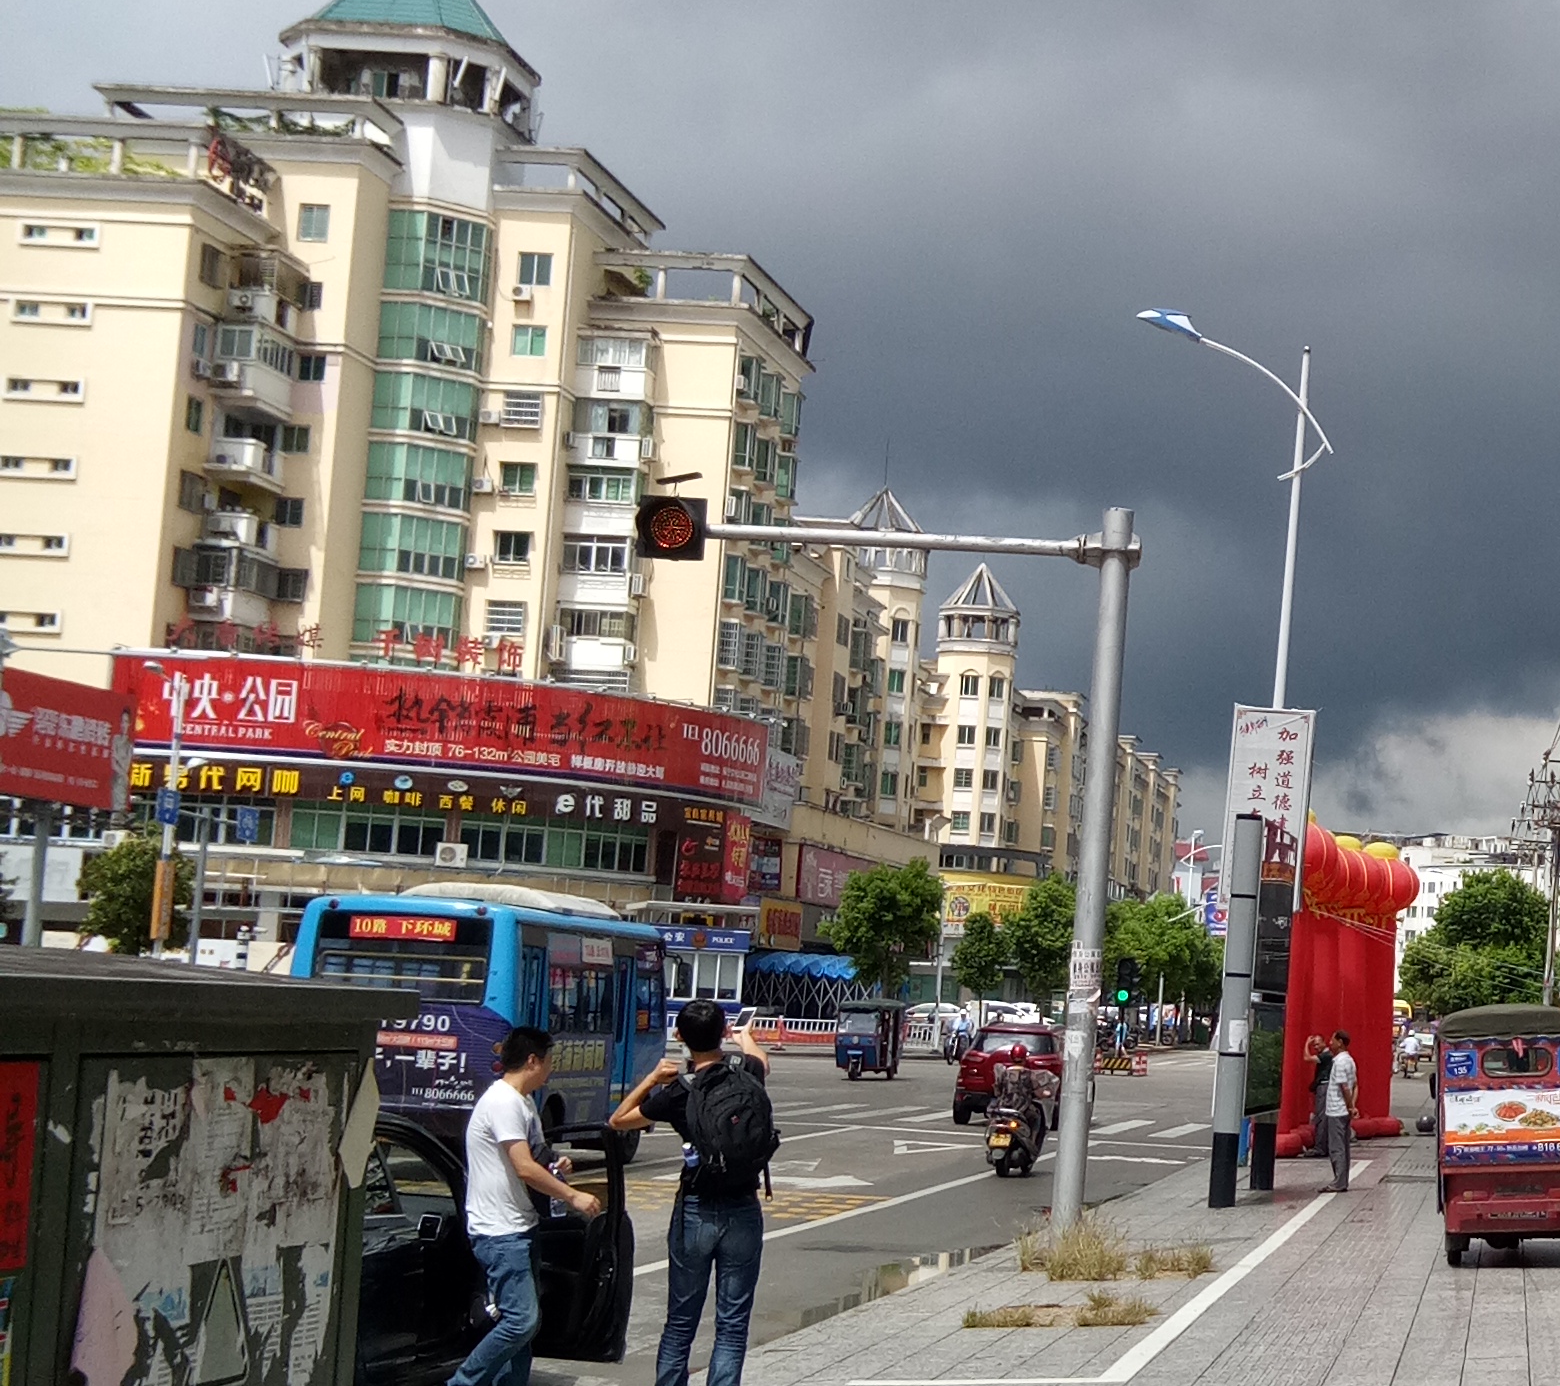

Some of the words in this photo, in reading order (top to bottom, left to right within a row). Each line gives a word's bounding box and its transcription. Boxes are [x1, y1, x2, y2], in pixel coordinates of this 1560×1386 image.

[162, 671, 220, 720] 中央
[237, 676, 299, 724] 公园
[179, 722, 237, 739] CENTRAL
[237, 725, 273, 741] PARK
[681, 722, 700, 741] TEL
[701, 726, 761, 767] 8066666
[383, 738, 443, 758] 实力封顶
[327, 785, 366, 803] 上网
[382, 790, 423, 807] 咖啡
[438, 795, 476, 811] 西餐
[490, 797, 527, 815] 休闲
[1247, 762, 1270, 816] 树立
[354, 917, 387, 934] 10路
[398, 919, 452, 937] 下环城
